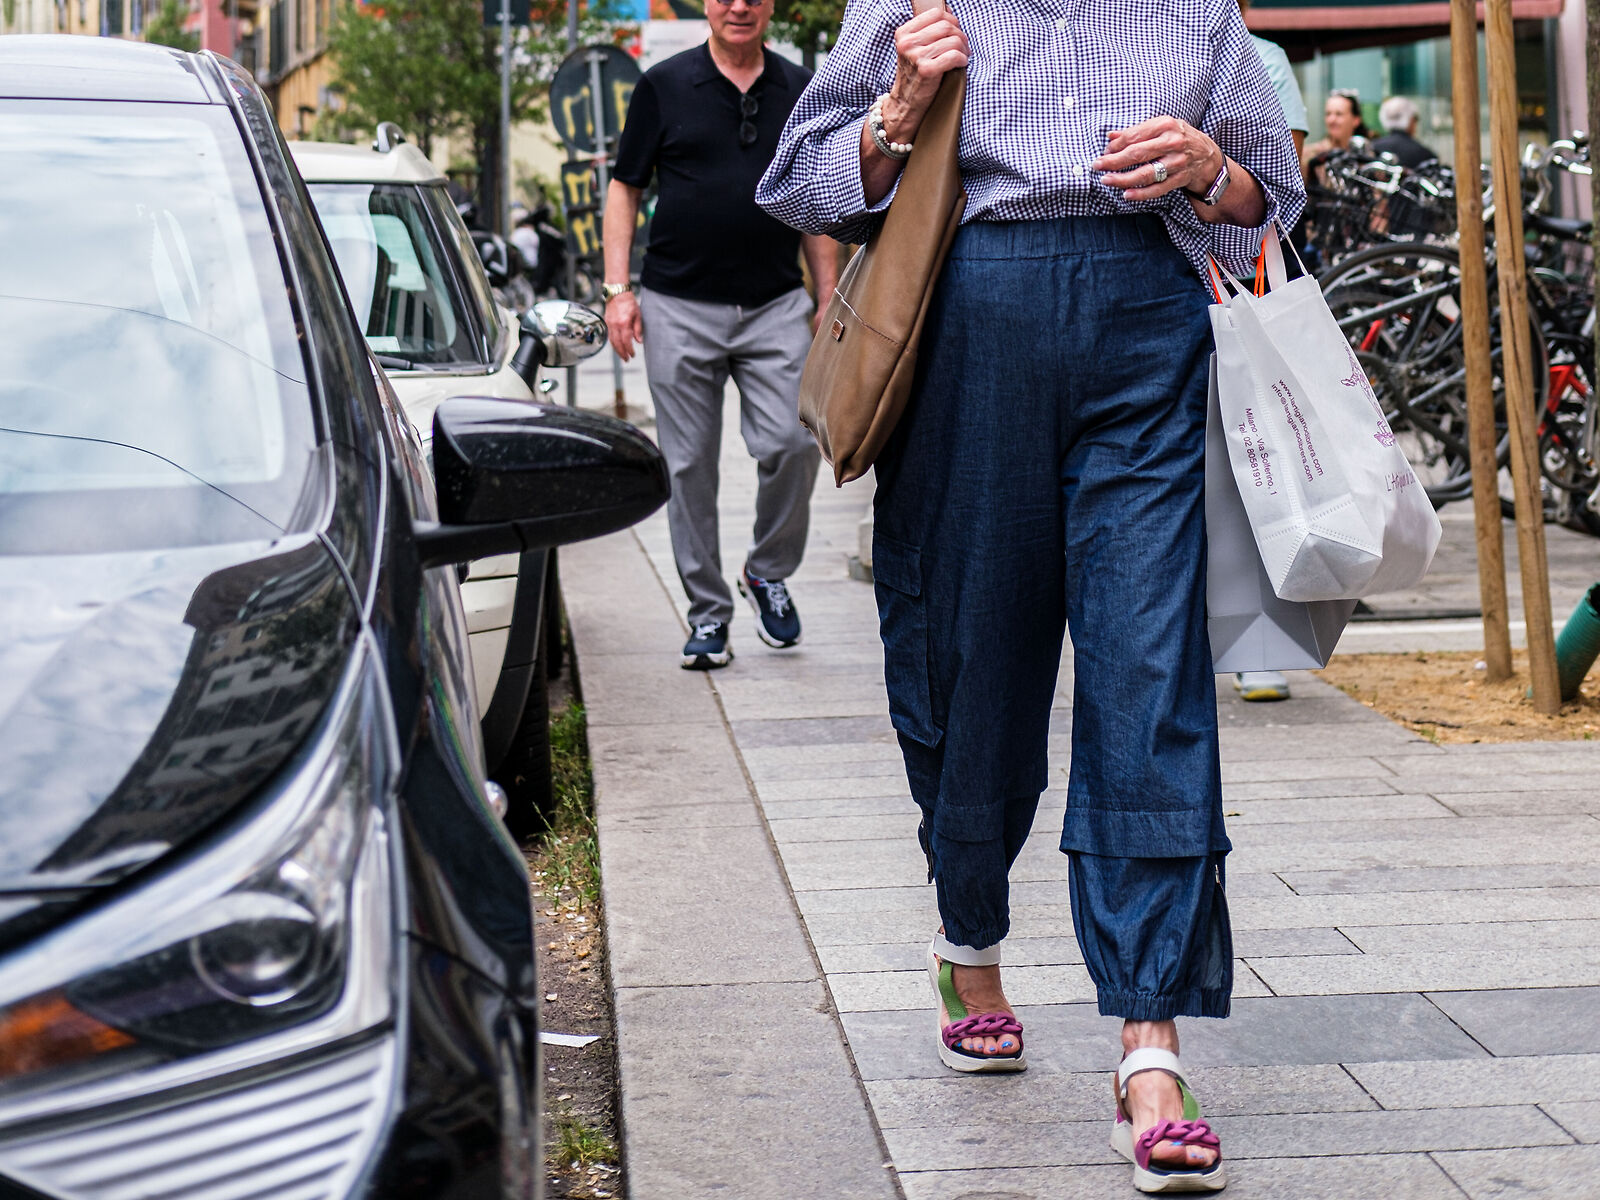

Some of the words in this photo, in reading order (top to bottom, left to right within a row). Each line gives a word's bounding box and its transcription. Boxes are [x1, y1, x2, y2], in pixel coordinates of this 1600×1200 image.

[1243, 436, 1252, 447] 02
[1245, 407, 1258, 433] Milano
[1256, 438, 1265, 452] Via
